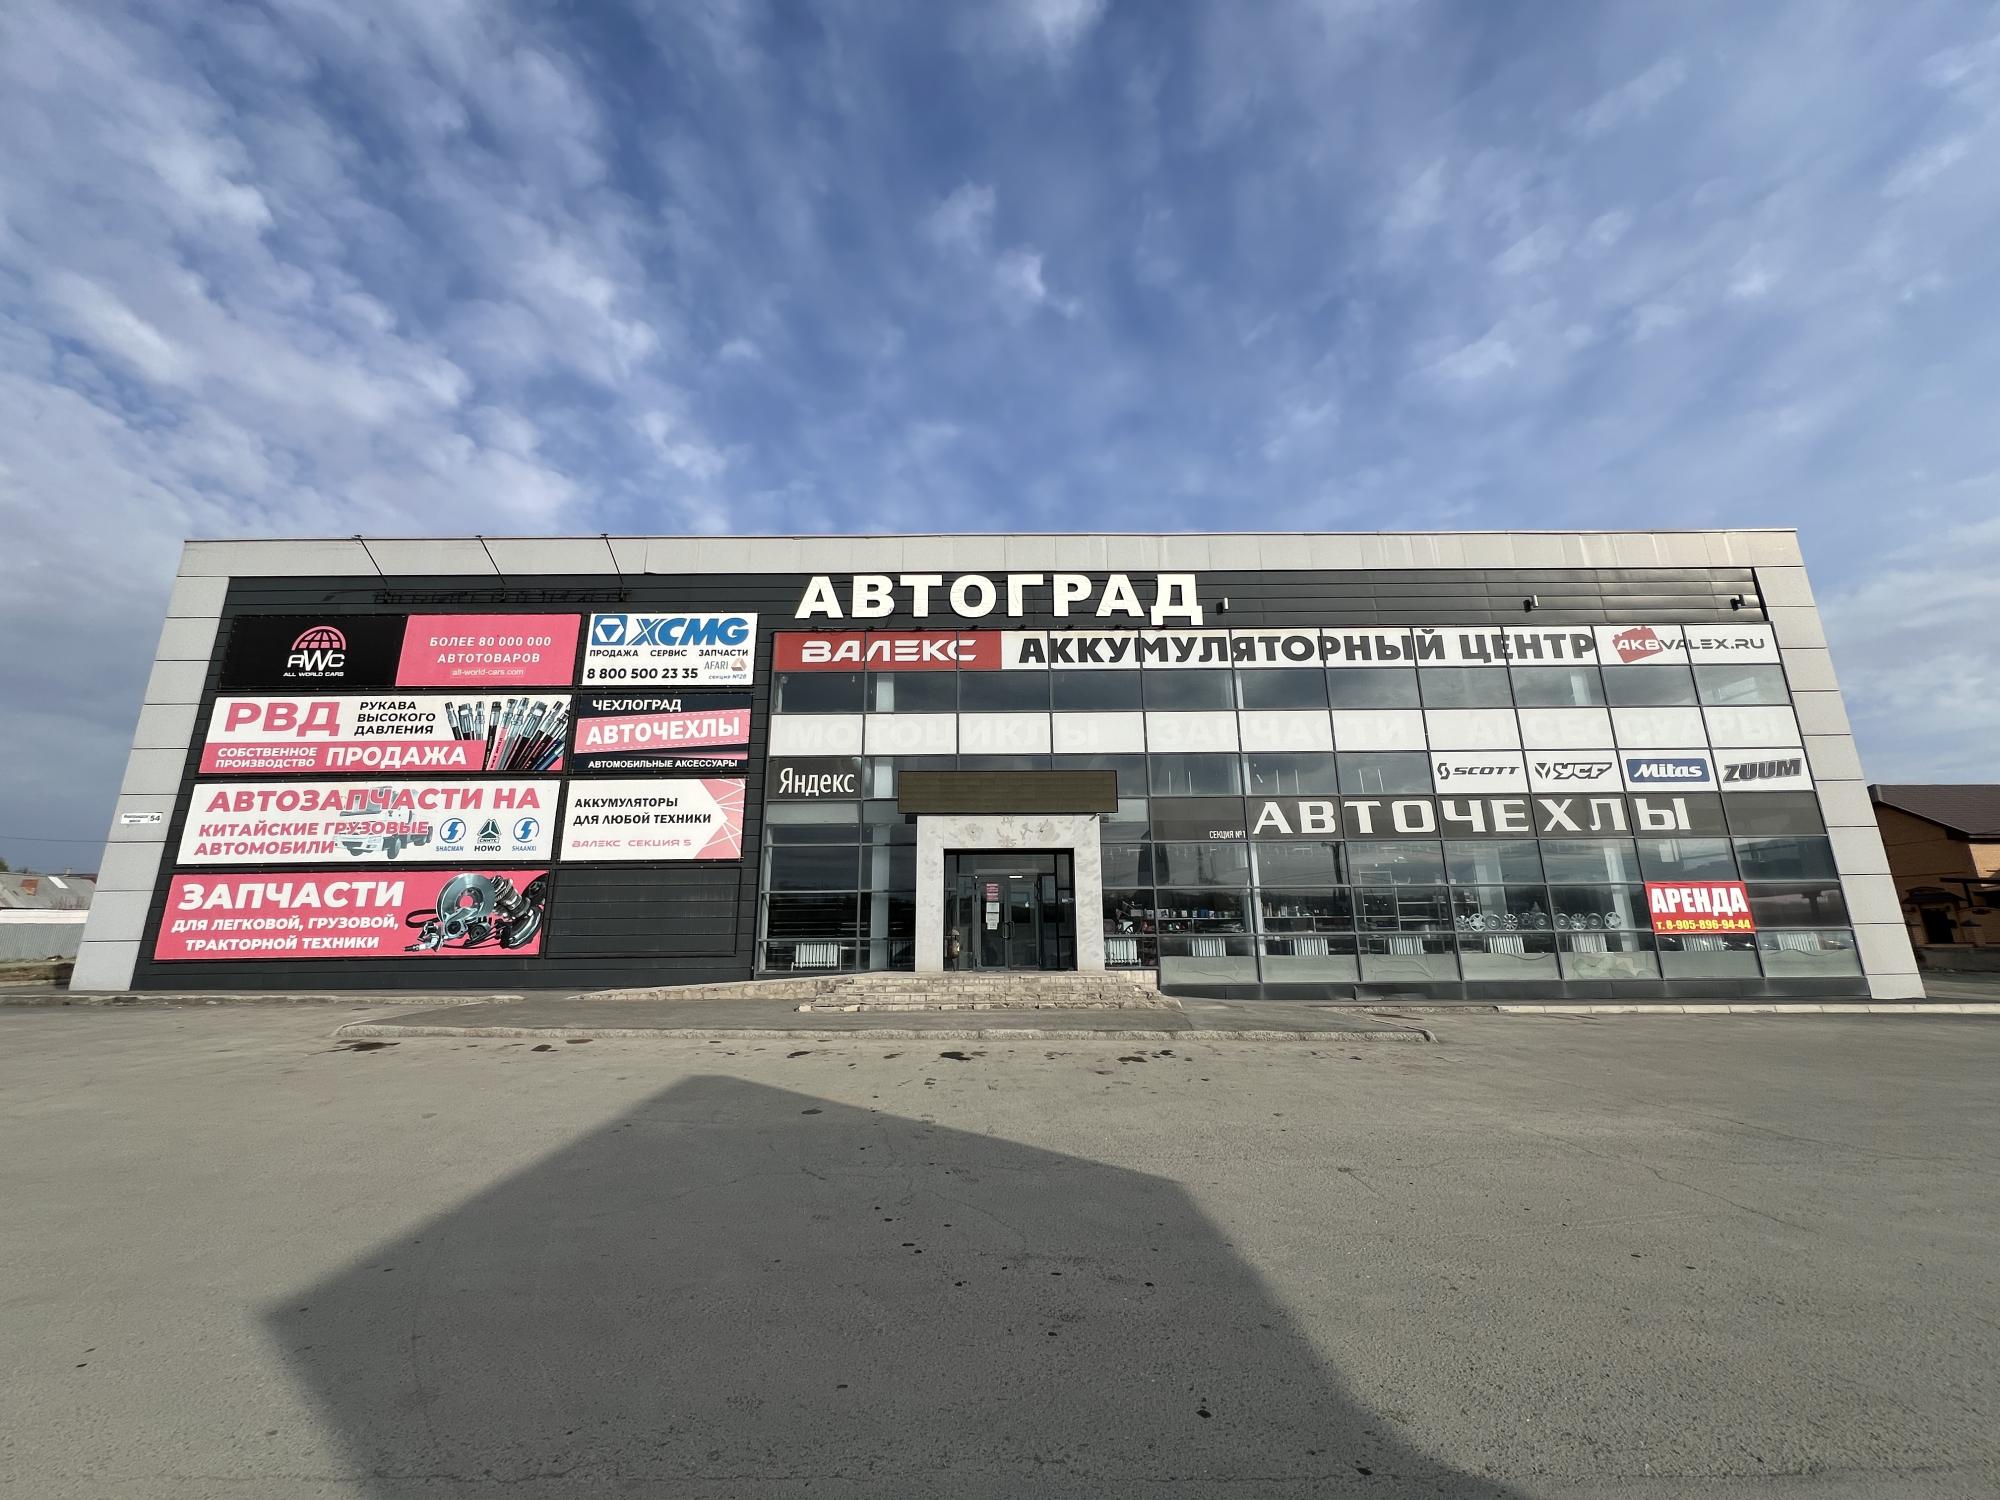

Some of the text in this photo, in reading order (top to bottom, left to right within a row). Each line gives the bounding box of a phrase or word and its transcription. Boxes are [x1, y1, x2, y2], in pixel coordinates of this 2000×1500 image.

[794, 573, 1204, 627] АВТОГРАД
[625, 617, 749, 646] XCMG
[429, 636, 552, 647] БОЛЕЕ 80 000 000
[1018, 628, 1595, 664] АККУМУЛЯТОРНЫЙ ЦЕНТР
[589, 649, 749, 658] ПРОДАЖА СЕРВИС ЗАПЧАСТИ
[801, 638, 977, 663] ВАЛЕКС
[287, 650, 345, 671] AWC
[437, 653, 541, 664] АВТОТОВАРОВ
[704, 660, 729, 670] AFARI
[452, 668, 524, 676] all-world-cars.com
[587, 668, 698, 679] 8 800 500 23 35
[359, 701, 417, 711] РУКАВА
[592, 699, 682, 712] ЧЕХЛОГРАД
[225, 701, 340, 737] РВД
[357, 713, 436, 723] ВЫСОКОГО
[354, 724, 434, 736] ДАВЛЕНИЯ
[586, 717, 740, 746] АВТОЧЕХЛЫ
[217, 747, 317, 757] СОБСТВЕННОЕ
[325, 745, 467, 769] ПРОДАЖА
[215, 758, 315, 768] ПРОИЗВОДСТВО
[588, 760, 737, 769] АВТОМОБИЛЬНЫЕ АКСЕССУАРЫ
[1453, 766, 1520, 775] SCOTT
[1634, 763, 1702, 778] Mitas
[1723, 758, 1802, 783] ZUUM
[778, 767, 856, 797] Яндекс
[206, 787, 541, 813] АВТОЗАПЧАСТИ НА
[574, 797, 678, 808] АККУМУЛЯТОРЫ
[573, 812, 711, 826] ДЛЯ ЛЮБОЙ ТЕХНИКИ
[1252, 797, 1692, 836] АВТОЧЕХЛЫ
[199, 820, 429, 837] КИТАЙСКИЕ ГРУЗОВЫЕ
[1209, 830, 1246, 839] СЕКЦИЯ №1
[194, 840, 334, 856] АВТОМОБИЛИ
[572, 839, 692, 848] ВАЛЕКС СЕКЦИЯ 5
[178, 881, 405, 910] ЗАПЧАСТИ
[1651, 887, 1749, 916] АРЕНДА
[171, 914, 399, 933] ДЛЯ ЛЕГКОВОЙ, ГРУЗОВОЙ,
[1666, 919, 1751, 930] 8-905-896-94-44
[186, 935, 379, 951] ТРАКТОРНОЙ ТЕХНИКИ
